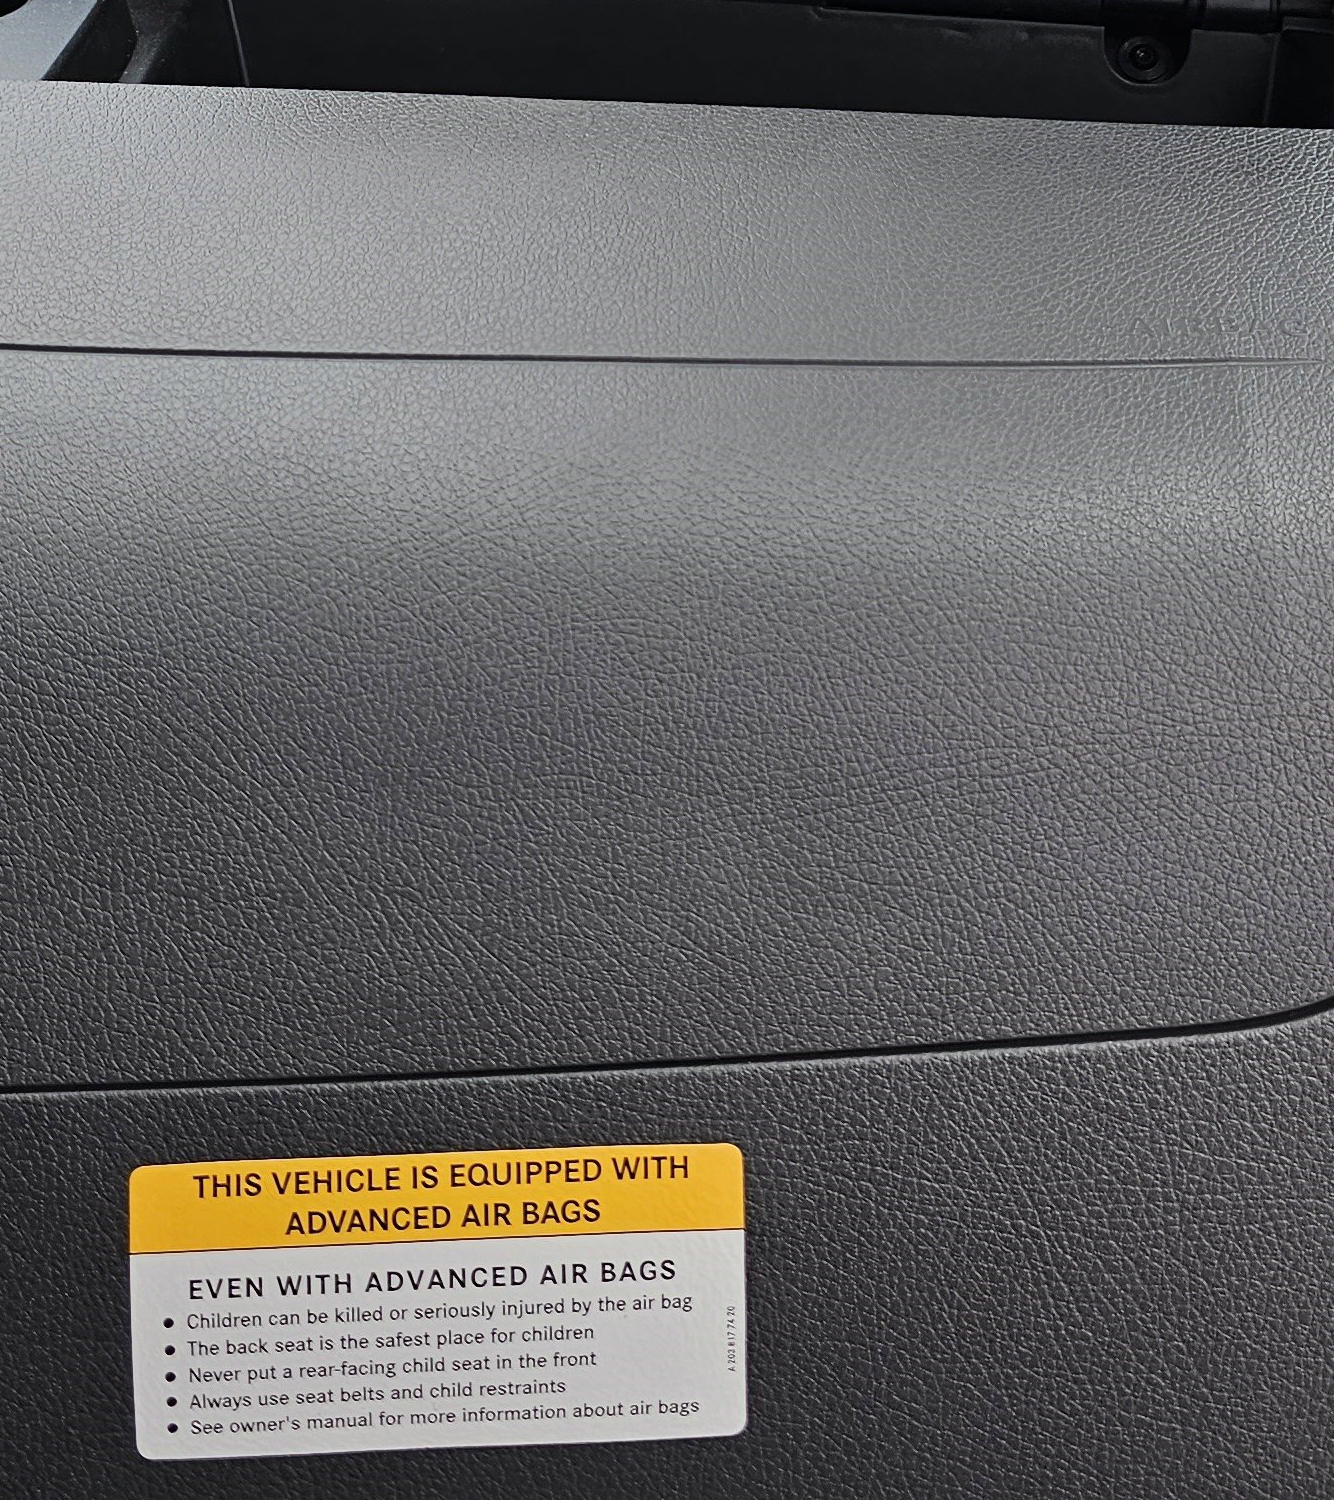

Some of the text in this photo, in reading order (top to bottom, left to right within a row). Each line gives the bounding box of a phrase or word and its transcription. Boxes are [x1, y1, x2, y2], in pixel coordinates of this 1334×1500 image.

[192, 1155, 688, 1197] THIS VEHICLE IS EQUIPPED WITH
[285, 1199, 600, 1234] ADVANCED AIR BAGS
[189, 1259, 675, 1299] EVEN WITH ADVANCED AIR BAGS
[186, 1293, 692, 1329] Children can be killed or seriously injured by the air bag
[186, 1325, 593, 1355] The back seat is the safest place for children
[189, 1351, 596, 1384] Never put a rear-facing child seat in the front
[189, 1379, 565, 1411] Always use seat belts and child restraints
[190, 1400, 699, 1434] See owner's manual for more information about air bags
